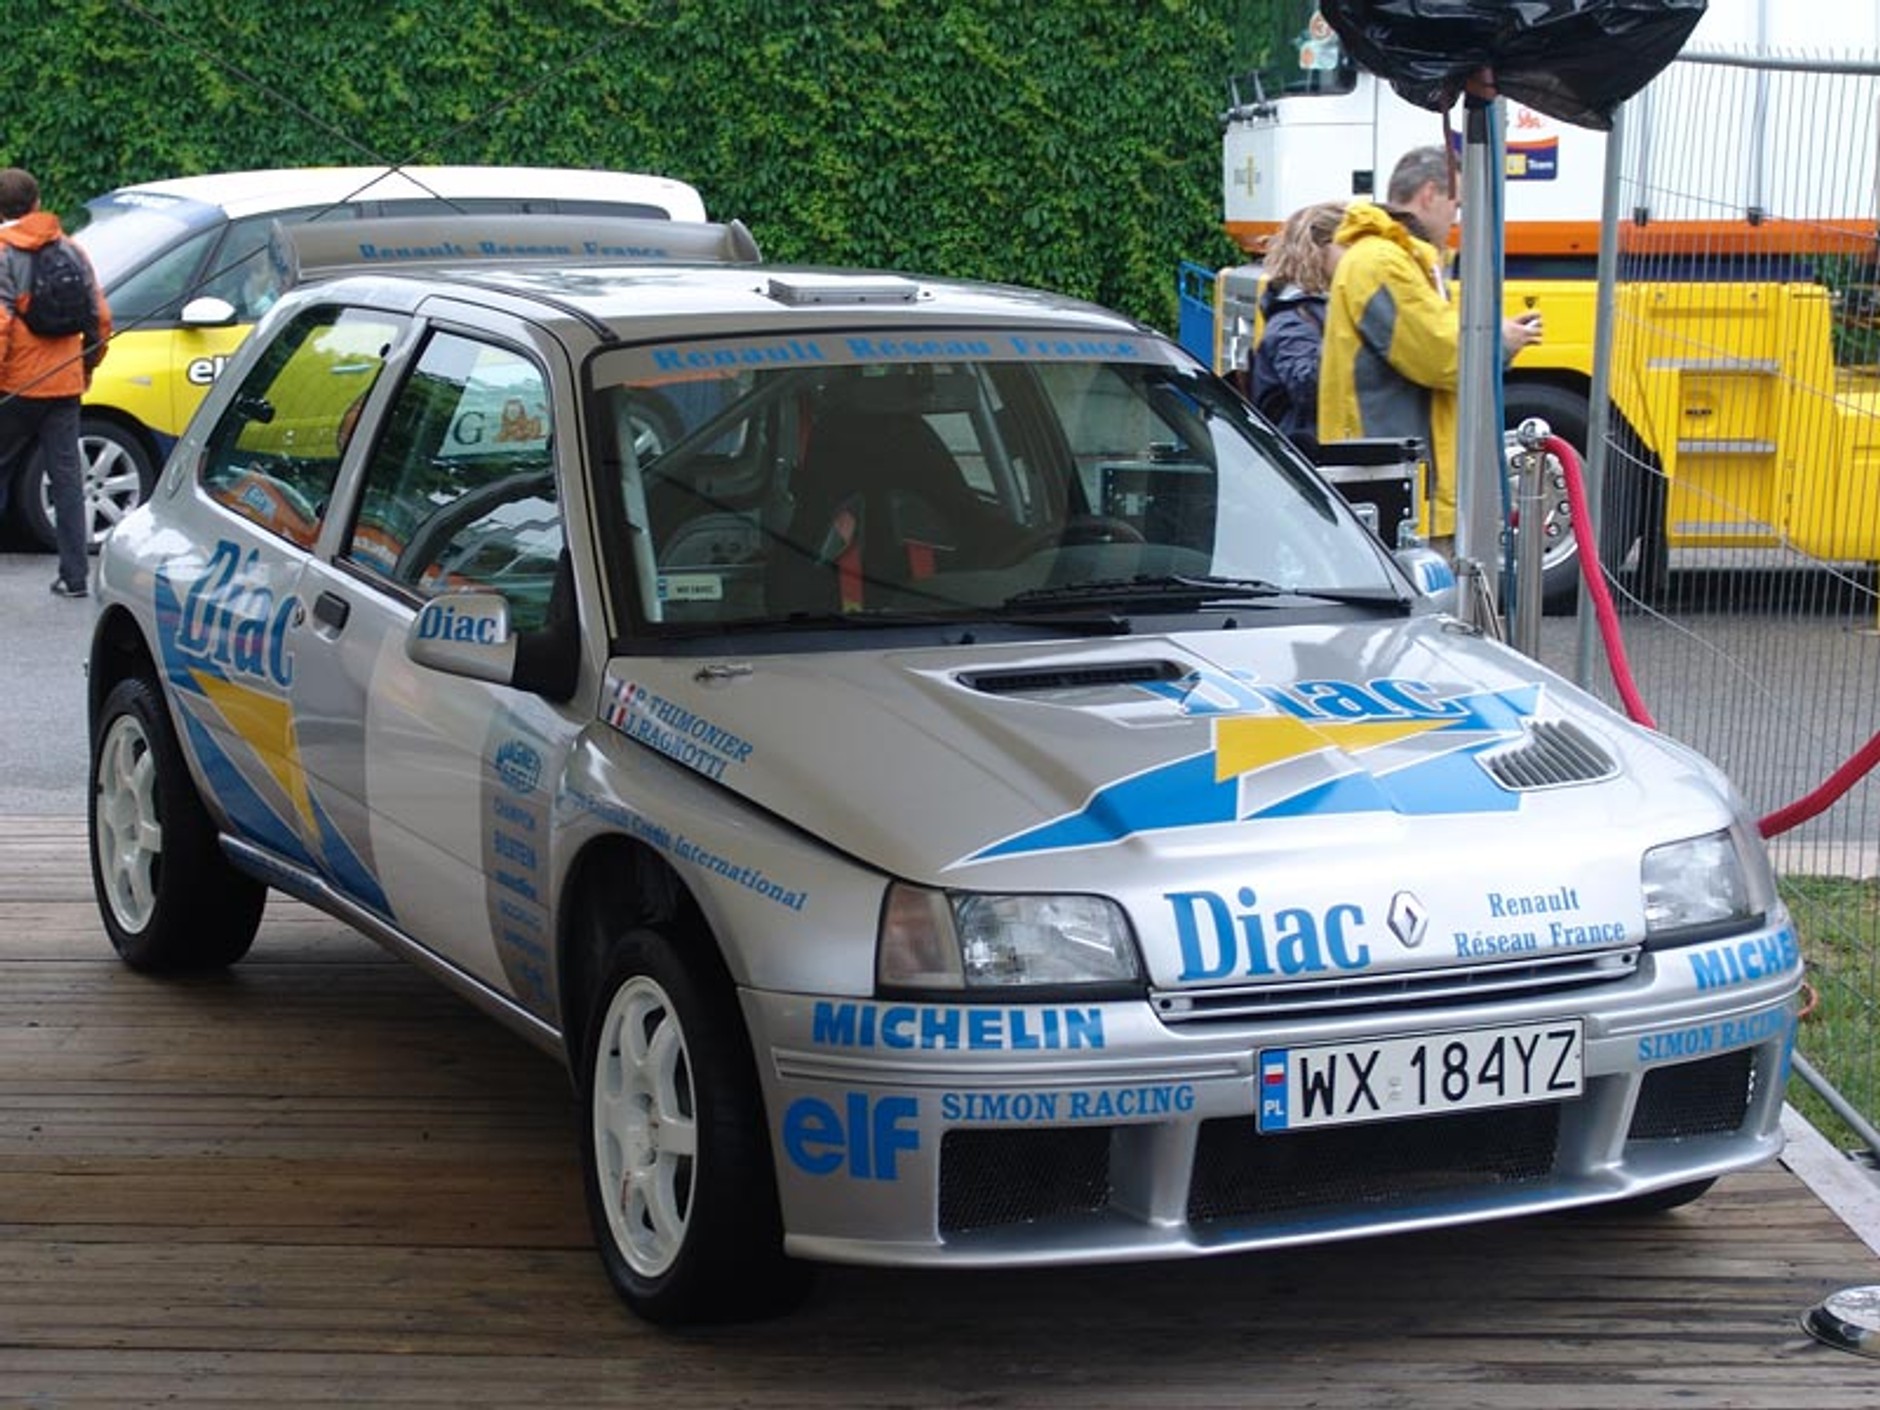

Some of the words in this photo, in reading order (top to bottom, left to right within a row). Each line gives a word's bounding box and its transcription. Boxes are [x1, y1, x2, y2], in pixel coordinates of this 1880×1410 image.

[188, 356, 232, 385] el
[651, 338, 824, 371] Renault
[1009, 336, 1137, 357] France
[177, 539, 299, 686] Diac
[418, 605, 497, 645] Diac
[1181, 668, 1470, 720] Diac
[673, 834, 809, 911] International
[1487, 885, 1581, 918] Renault
[1164, 886, 1372, 982] Diac
[1454, 930, 1538, 958] Réseau
[1549, 920, 1626, 948] France
[1688, 926, 1799, 991] MICHE
[811, 1001, 1106, 1050] MICHELIN
[1639, 1024, 1714, 1062] SIMON
[1300, 1049, 1381, 1118] WX
[1411, 1029, 1577, 1106] 184YZ
[942, 1091, 1058, 1121] SIMON
[1069, 1085, 1195, 1120] RACING
[1263, 1099, 1286, 1117] PL
[782, 1091, 920, 1181] elf
